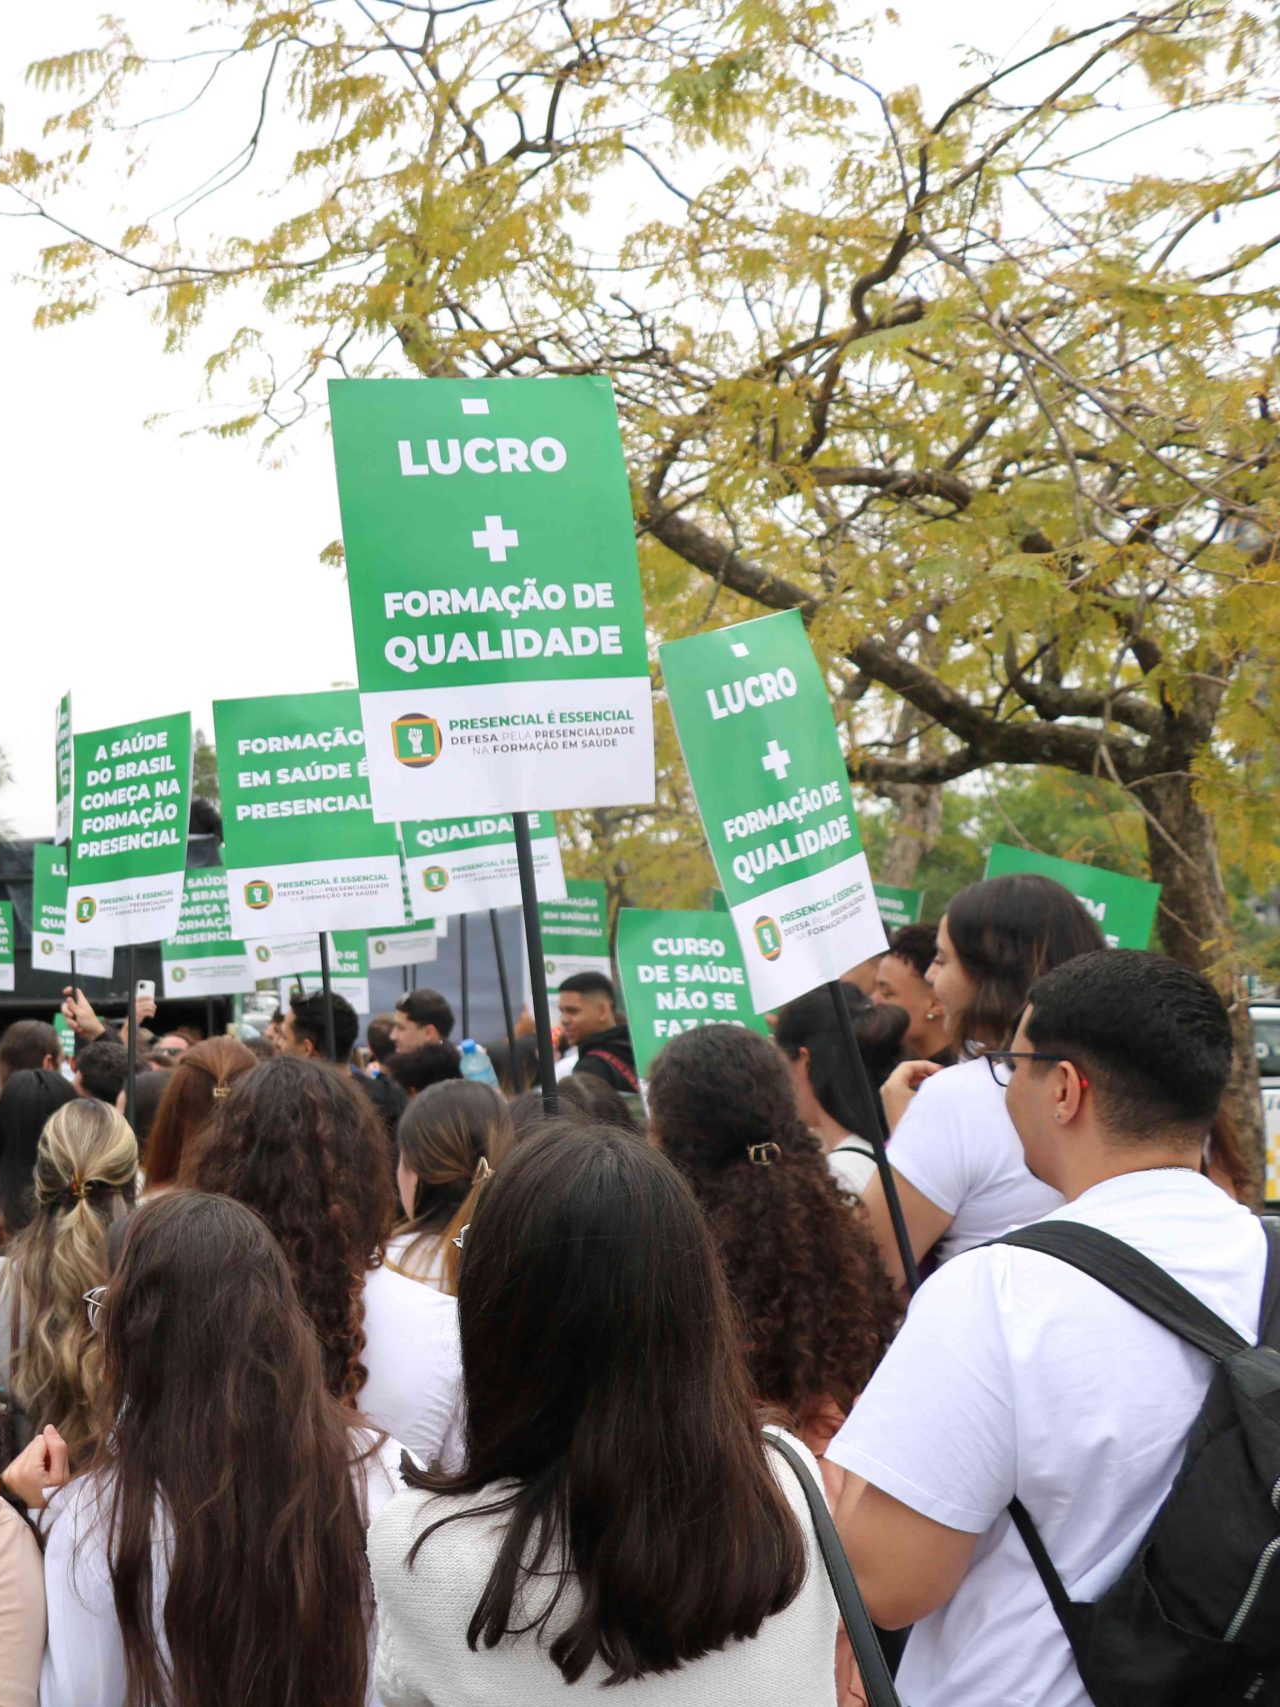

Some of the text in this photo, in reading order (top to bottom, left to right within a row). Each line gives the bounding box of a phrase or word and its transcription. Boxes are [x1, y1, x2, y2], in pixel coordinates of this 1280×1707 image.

[397, 436, 567, 476] LUCRO
[384, 578, 614, 619] FORMAÇÃO DE
[384, 625, 622, 673] QUALIDADE
[706, 666, 798, 720] LUCRO
[449, 709, 634, 731] PRESENCIAL É ESSENCIAL
[450, 725, 635, 745] DEFESA PELA PRESENCIALIDADE
[95, 732, 168, 762] A SAÚDE
[237, 728, 365, 756] FORMAÇÃO
[473, 735, 618, 755] NA FORMAÇÃO EM SAÚDE
[86, 755, 176, 788] DO BRASIL
[238, 759, 370, 789] EM SAÚDE É
[81, 778, 181, 811] COMEÇA NA
[81, 802, 178, 835] FORMAÇÃO
[723, 781, 841, 842] FORMAÇÃO DE
[77, 827, 180, 859] PRESENCIAL
[416, 814, 541, 848] QUALIDAE
[732, 814, 852, 884] QUALIDADE
[277, 874, 389, 889] PRESENCIAL É ESSENCIAL
[326, 883, 390, 892] PRESENCIALIDADE
[780, 898, 833, 924] PRESENCIAL
[783, 921, 810, 937] DEFESA
[652, 938, 725, 957] CURSO
[638, 961, 745, 984] DE SAÚDE
[656, 987, 737, 1011] NÃO SE
